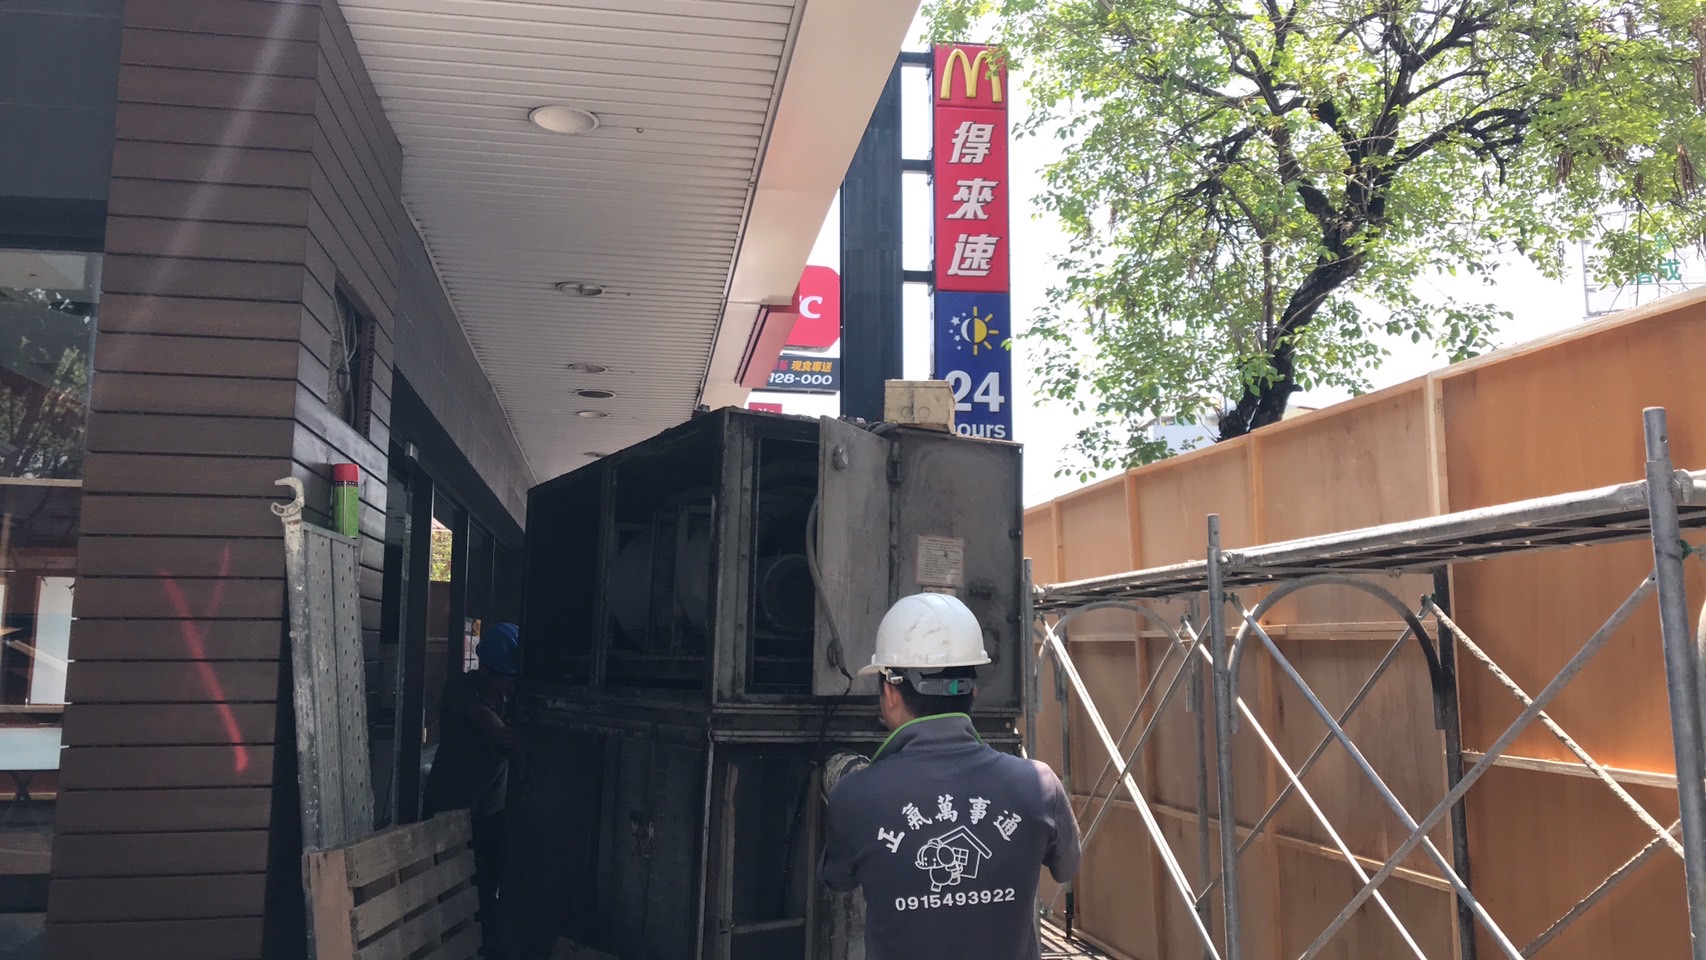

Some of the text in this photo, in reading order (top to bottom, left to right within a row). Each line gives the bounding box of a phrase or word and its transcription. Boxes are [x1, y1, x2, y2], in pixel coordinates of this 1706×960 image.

[946, 120, 1001, 277] 得來速
[768, 372, 833, 385] 128-000
[944, 369, 1006, 413] 24
[955, 422, 1007, 439] ours
[877, 793, 1022, 854] 正氣萬事通
[895, 887, 1016, 911] 0915493922
